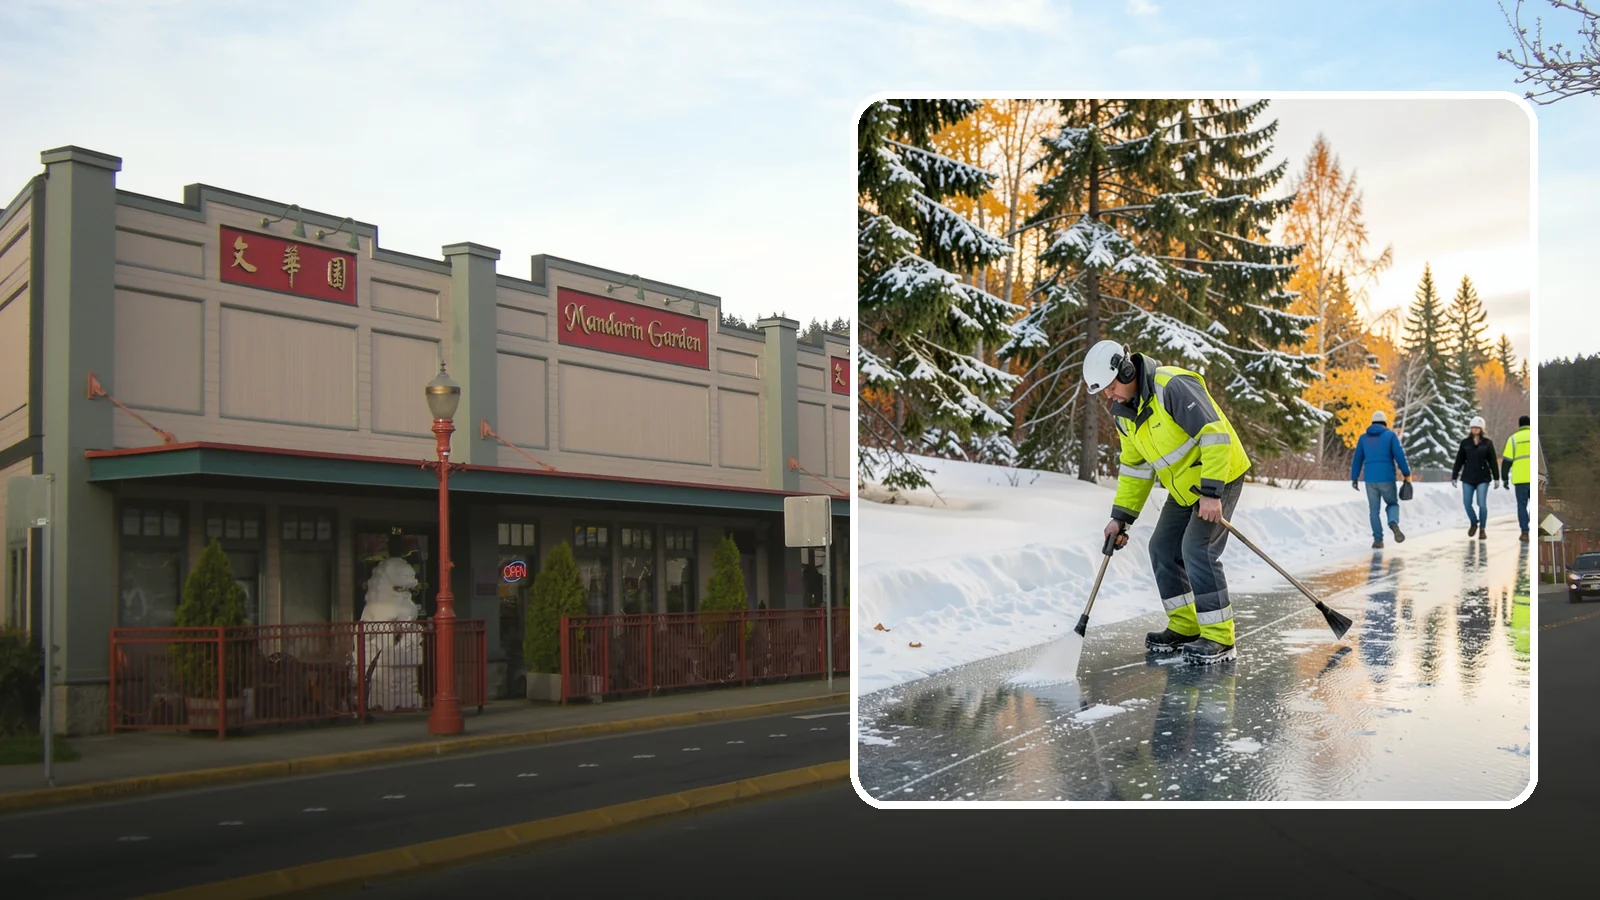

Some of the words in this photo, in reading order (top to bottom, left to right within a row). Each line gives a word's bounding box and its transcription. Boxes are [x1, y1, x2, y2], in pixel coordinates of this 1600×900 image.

[231, 236, 346, 291] 文華園
[564, 302, 644, 340] Mandarin
[648, 320, 701, 352] Garden
[503, 565, 527, 578] OPEN
